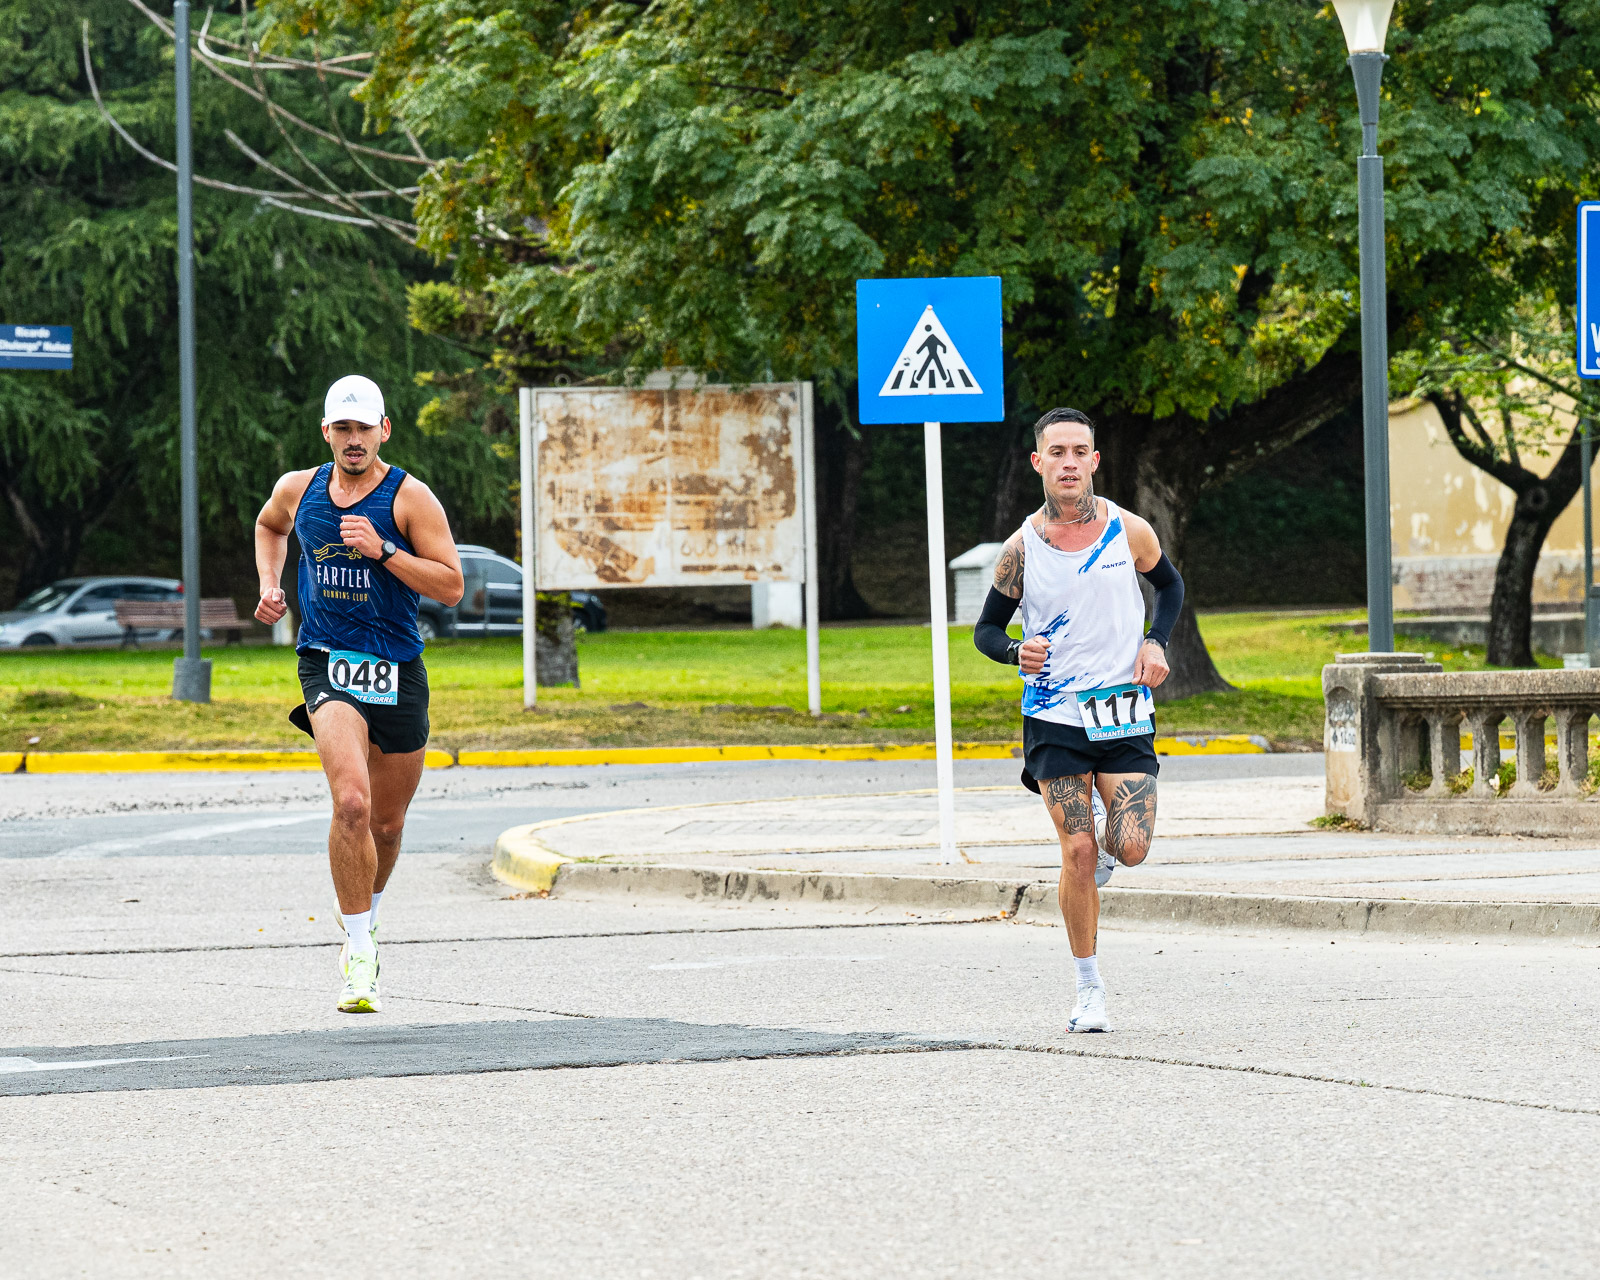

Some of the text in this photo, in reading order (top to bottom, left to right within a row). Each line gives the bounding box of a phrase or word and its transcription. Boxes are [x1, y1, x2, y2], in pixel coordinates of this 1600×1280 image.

[317, 565, 370, 588] FARTLEK
[323, 590, 368, 602] RUNNING CLUB
[333, 658, 392, 694] 048
[1084, 690, 1138, 729] 117
[1091, 726, 1149, 739] DIAMANTE CORRE
